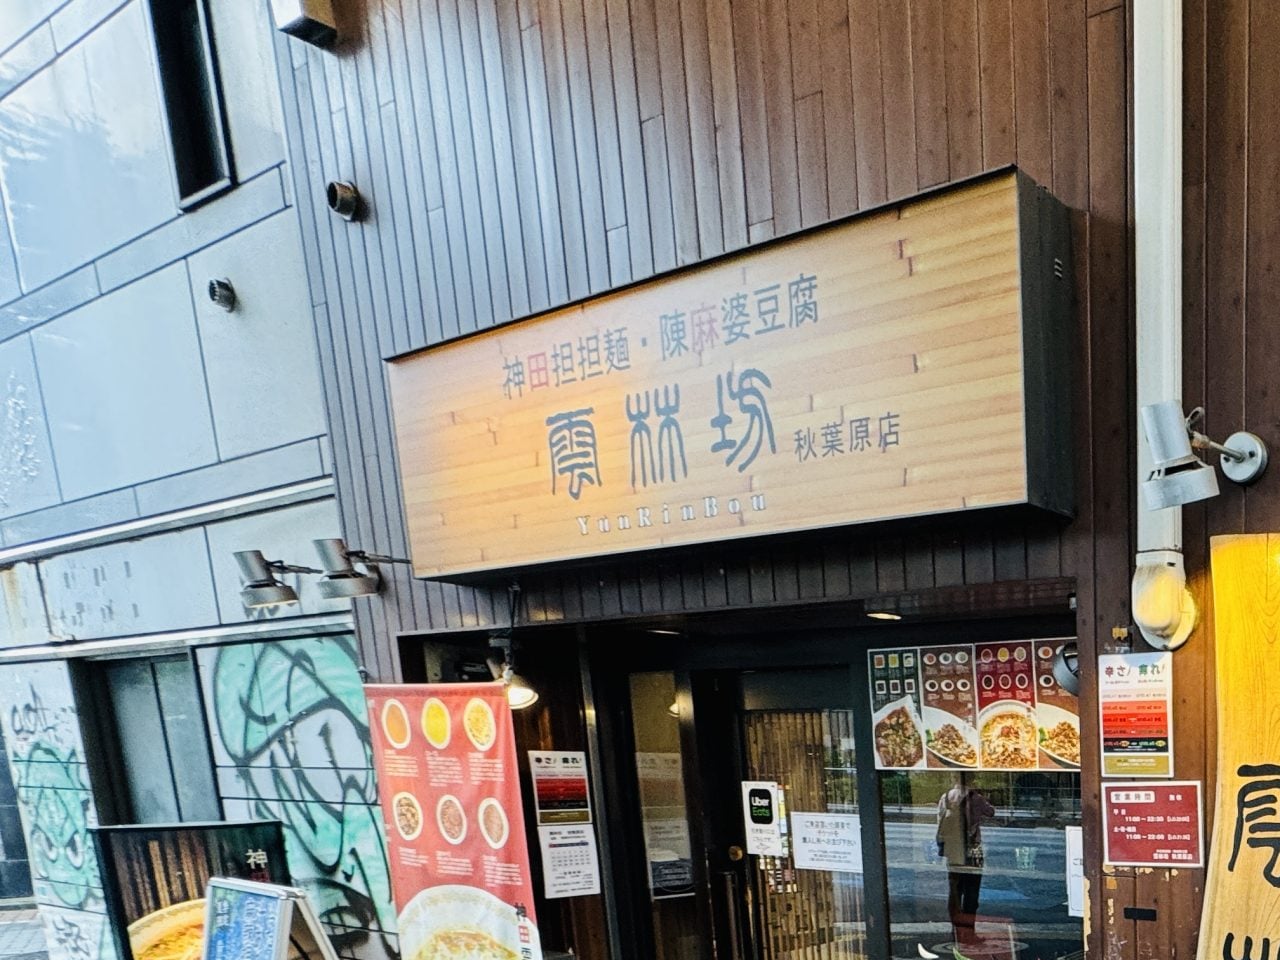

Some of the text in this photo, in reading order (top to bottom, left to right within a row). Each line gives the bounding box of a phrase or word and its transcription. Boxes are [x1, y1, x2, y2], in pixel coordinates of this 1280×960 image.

[501, 273, 818, 399] 神田担担麺・陳麻婆豆腐
[545, 368, 900, 500] 雲林坊 秋葉原店
[576, 494, 767, 535] YunRinBou
[751, 796, 769, 806] Uber
[752, 806, 770, 817] Eats
